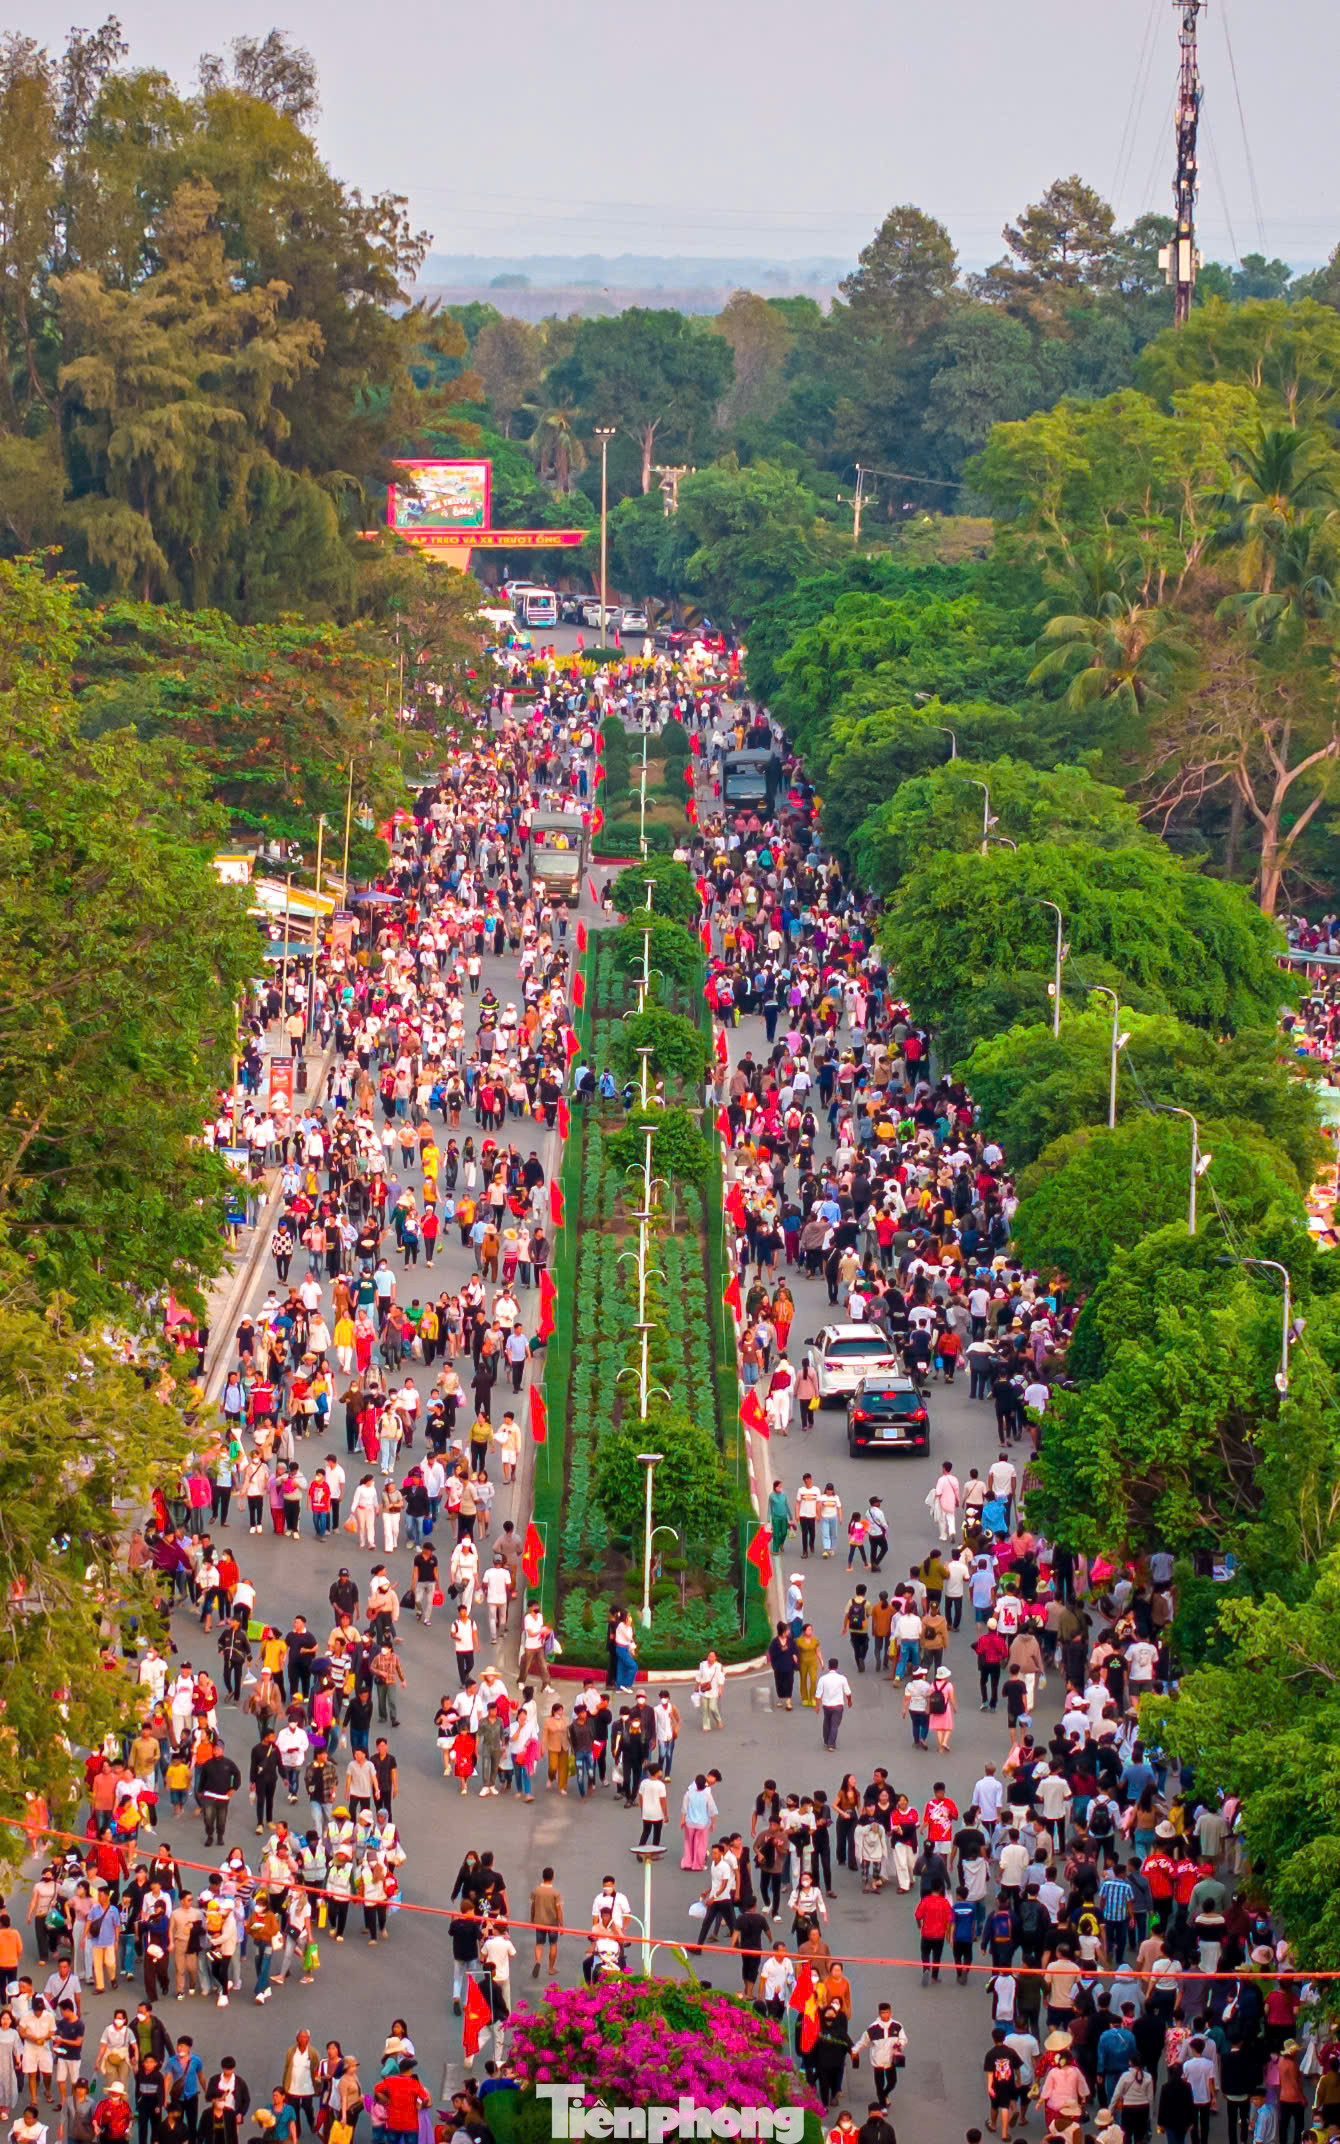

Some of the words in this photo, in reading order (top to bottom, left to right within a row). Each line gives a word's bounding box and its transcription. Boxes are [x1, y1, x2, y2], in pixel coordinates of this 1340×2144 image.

[431, 535, 459, 545] TREO
[480, 535, 493, 545] XE
[536, 533, 562, 545] ỐNG
